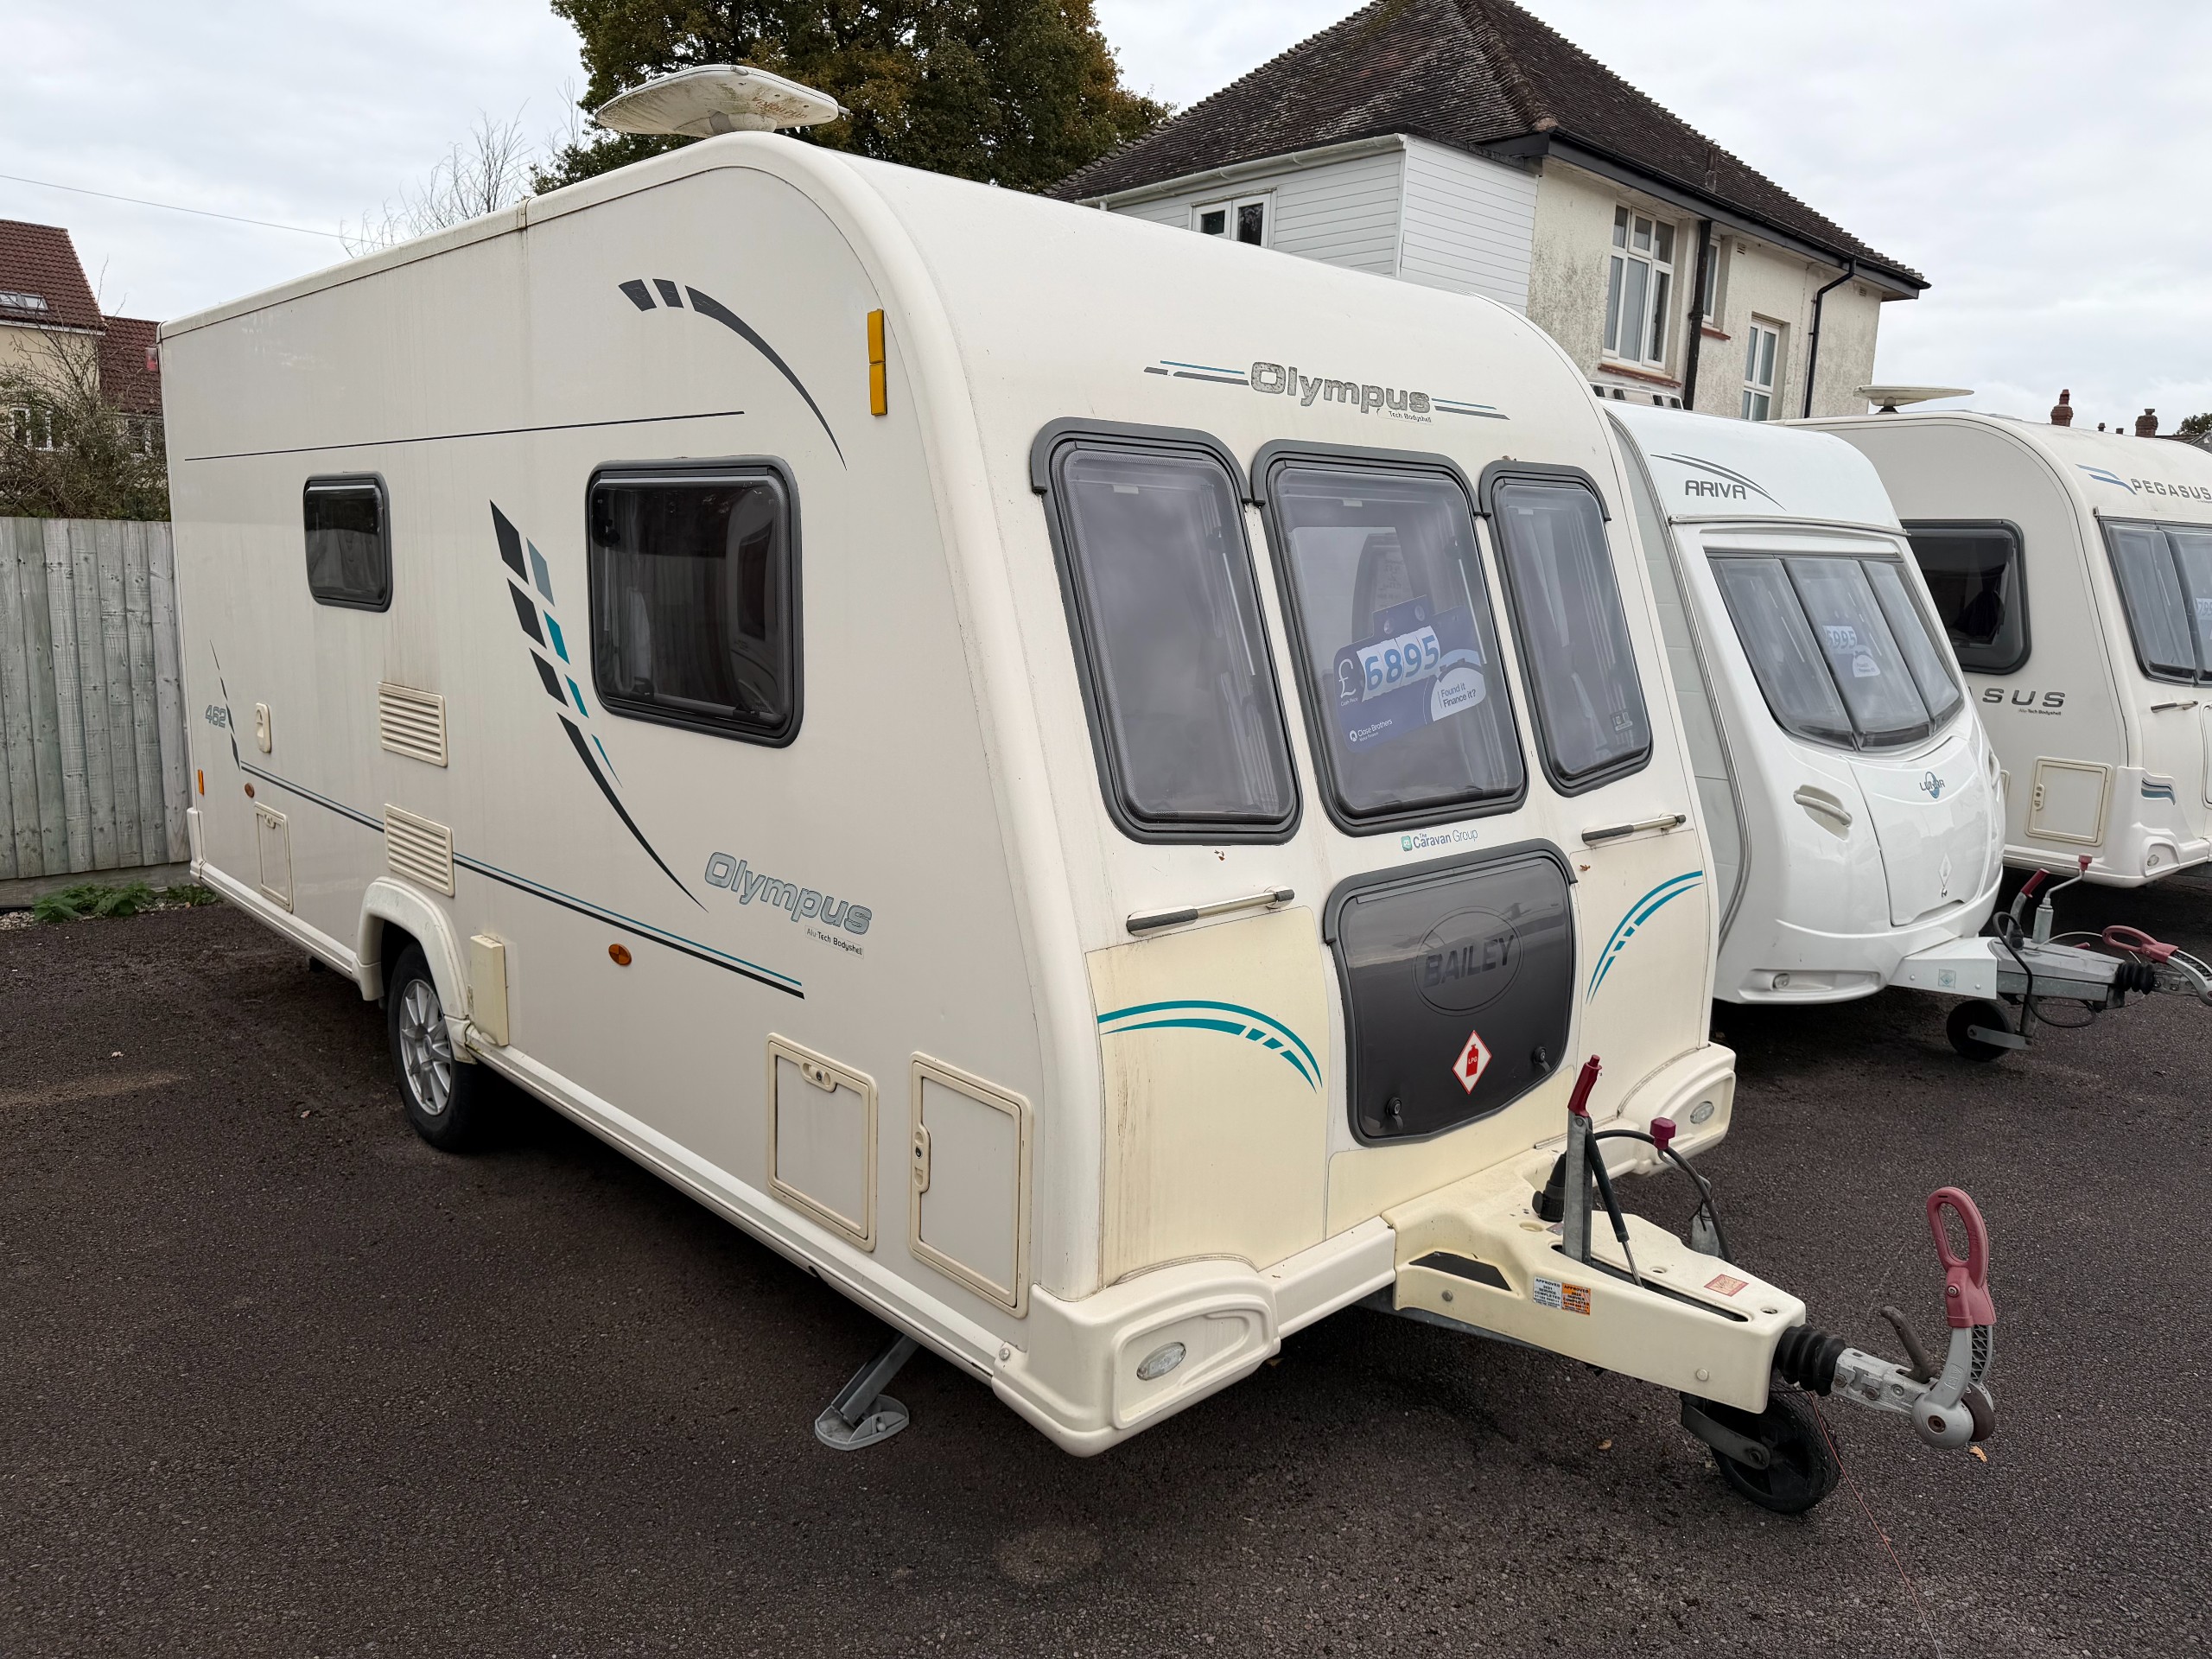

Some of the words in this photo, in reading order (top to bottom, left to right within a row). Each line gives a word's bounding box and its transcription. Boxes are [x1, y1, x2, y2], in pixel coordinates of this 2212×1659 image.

[1251, 361, 1431, 414] Olympus
[1685, 480, 1746, 499] ARIVA
[2130, 478, 2212, 500] PEGASUS
[1441, 683, 1460, 698] Found
[1443, 694, 1467, 708] Finance
[1467, 689, 1477, 699] it?
[206, 704, 226, 728] 462
[1357, 728, 1372, 737] Close
[1371, 719, 1393, 732] Brothers
[1414, 834, 1452, 849] Caravan
[1452, 830, 1478, 842] Group
[704, 852, 873, 935] Olympus
[833, 937, 863, 956] Bodyshell
[1423, 934, 1515, 988] BAILEY
[1468, 1056, 1478, 1065] LPG
[1535, 1278, 1560, 1287] APPROVED
